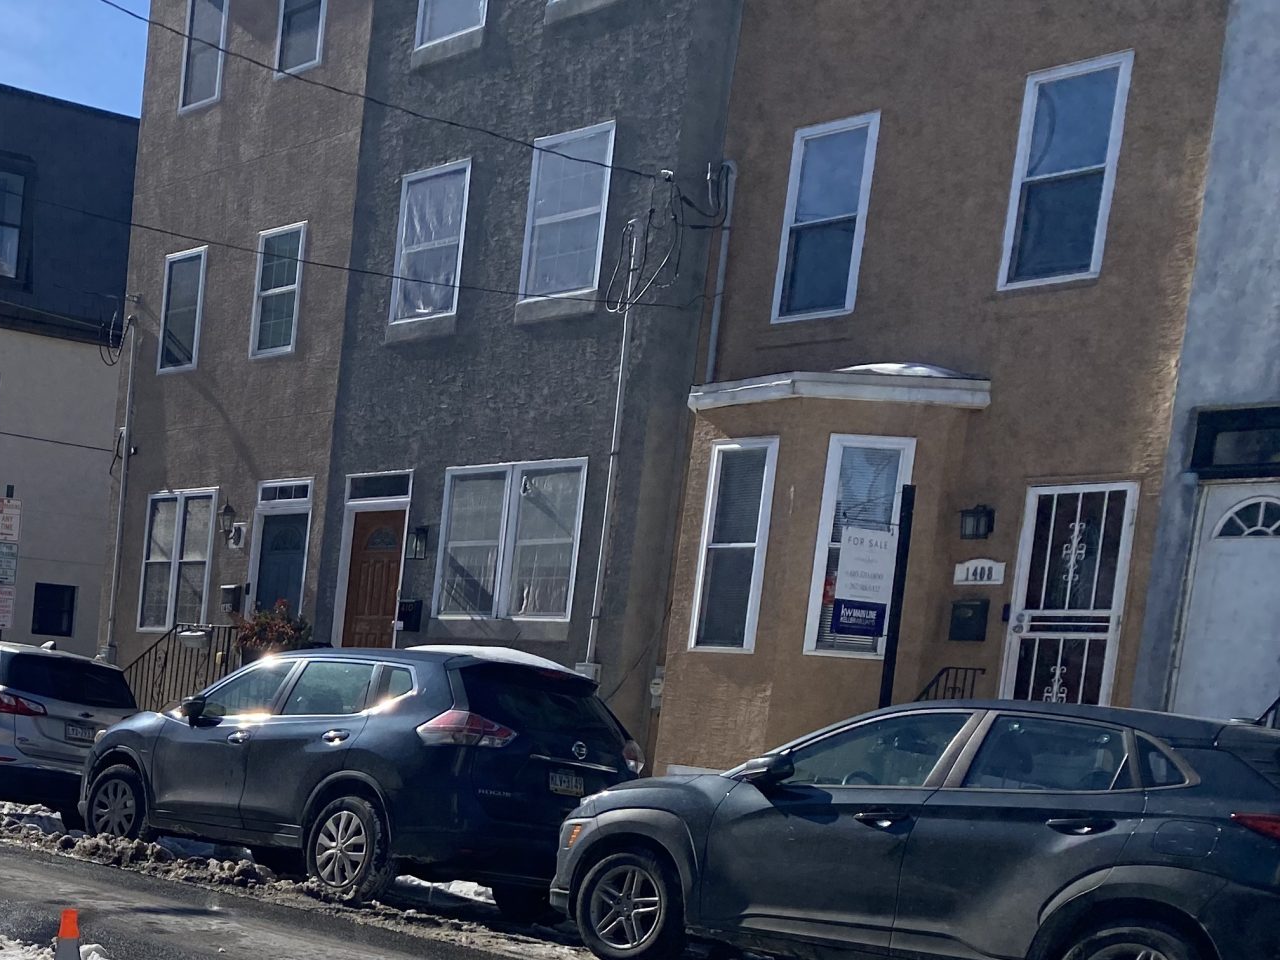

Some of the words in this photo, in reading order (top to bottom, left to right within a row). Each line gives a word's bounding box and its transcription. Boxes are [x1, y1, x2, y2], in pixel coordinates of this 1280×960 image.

[847, 535, 865, 546] FOR
[868, 538, 888, 550] SALE
[964, 566, 993, 580] 1408
[840, 604, 853, 617] kw
